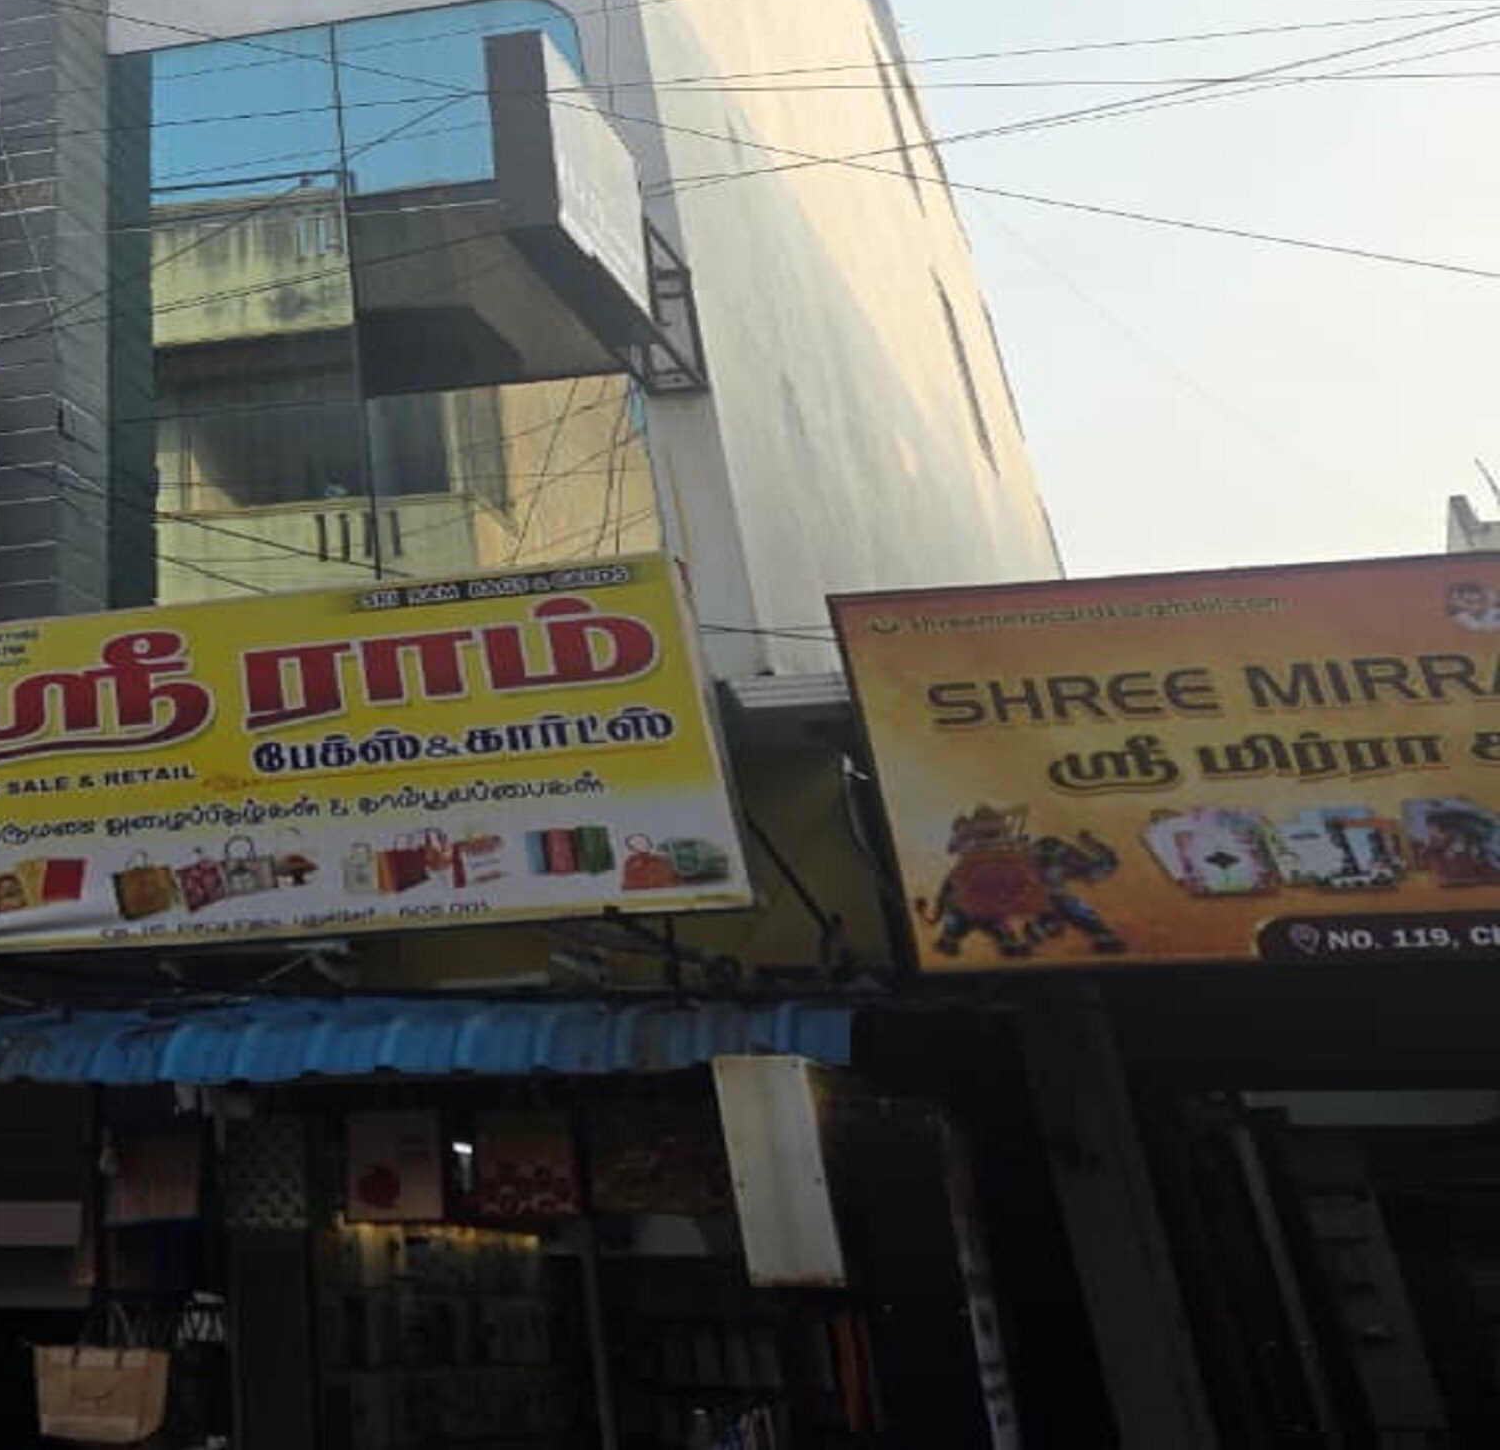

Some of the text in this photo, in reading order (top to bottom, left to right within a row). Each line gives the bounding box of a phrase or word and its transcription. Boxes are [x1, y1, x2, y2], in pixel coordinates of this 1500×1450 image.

[243, 596, 656, 731] ராம்
[927, 653, 1500, 726] SHREE MIRR
[1197, 731, 1444, 778] மிர்ரா
[8, 776, 71, 794] SALE
[78, 775, 95, 787] &
[104, 766, 196, 785] RETAIL
[1328, 929, 1382, 950] NO.
[1390, 926, 1459, 950] 119,
